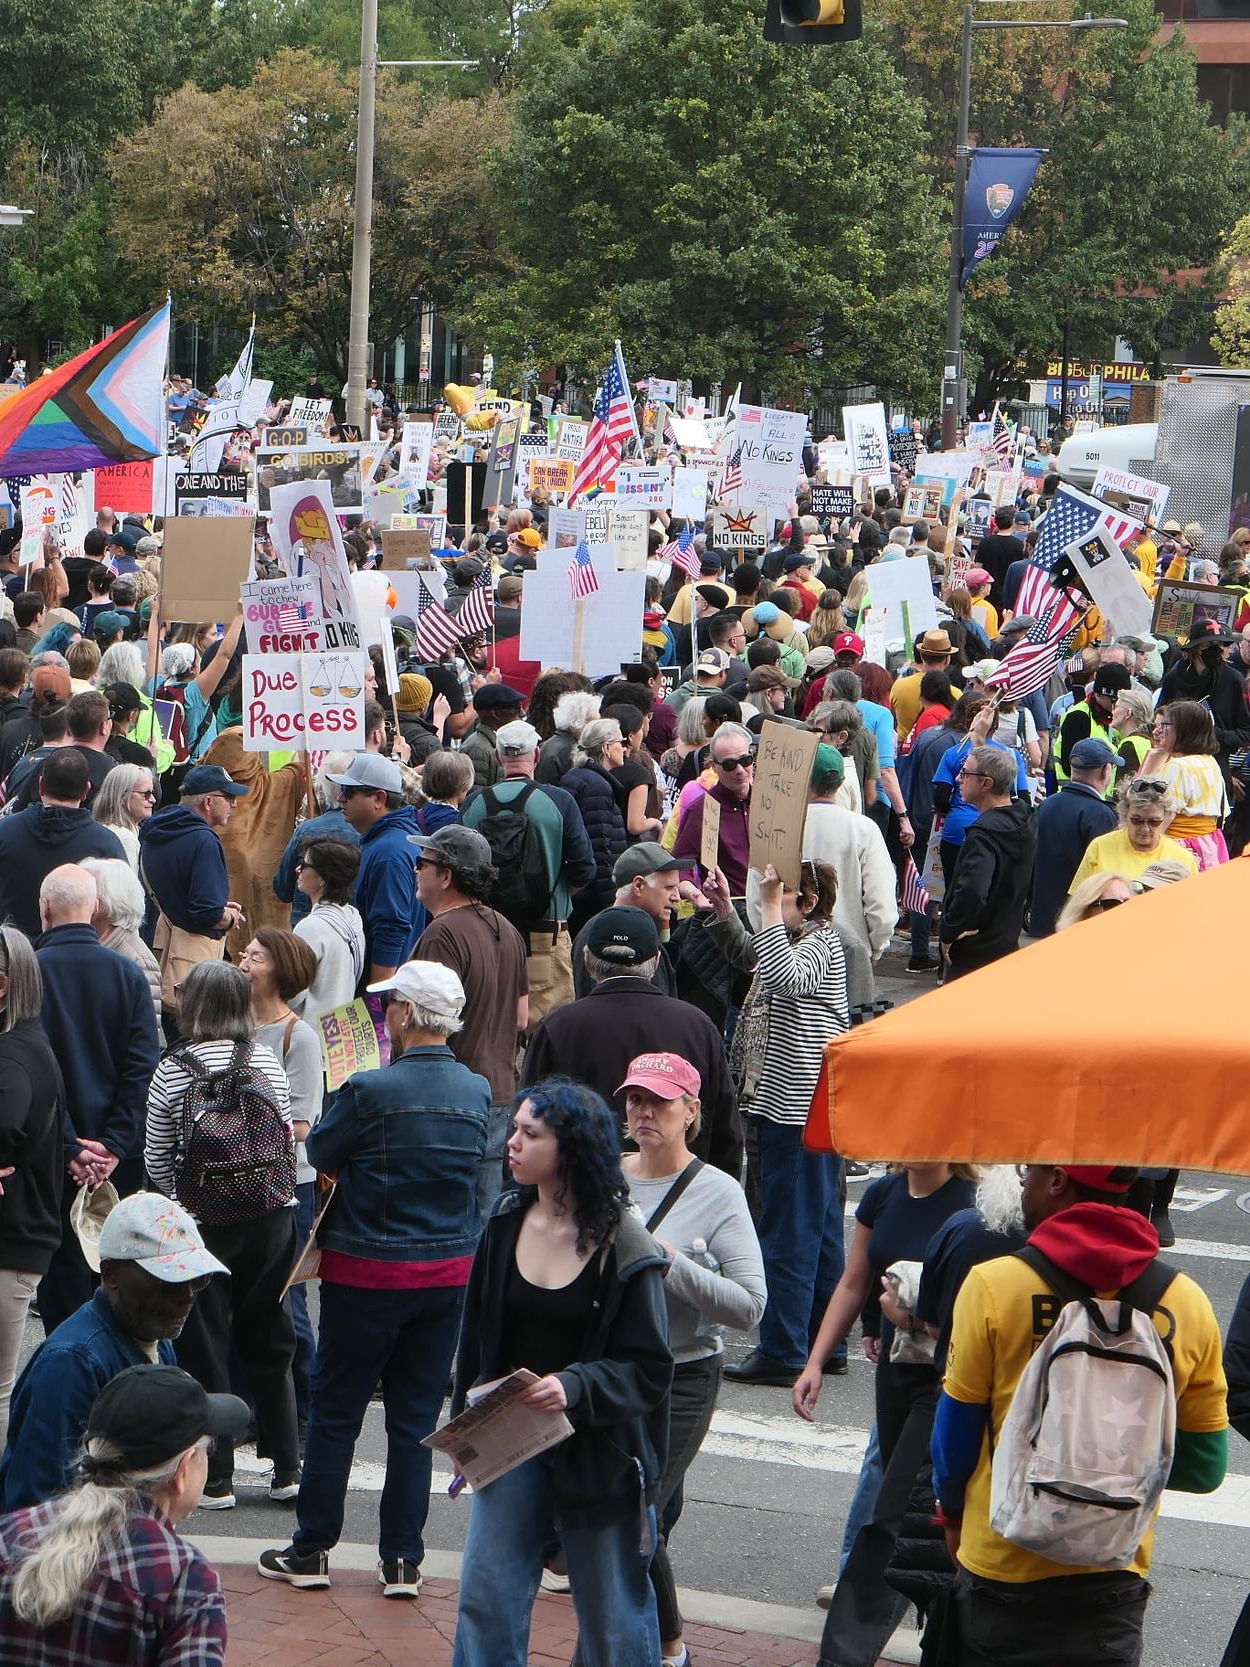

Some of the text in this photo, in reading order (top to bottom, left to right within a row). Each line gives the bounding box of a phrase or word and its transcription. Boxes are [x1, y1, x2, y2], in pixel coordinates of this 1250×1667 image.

[1053, 386, 1077, 402] Hp
[305, 400, 322, 409] LET
[299, 452, 350, 465] BIRDS!
[1086, 452, 1100, 461] 5011
[97, 465, 150, 477] AMERICA
[547, 467, 568, 477] BREAK
[175, 476, 246, 492] ONE AND THE
[1103, 471, 1140, 492] PROTECT
[1143, 486, 1160, 499] OUR
[812, 489, 852, 497] HATE WILL
[812, 497, 852, 506] NOT MAKE
[812, 505, 852, 513] US GREAT
[714, 533, 765, 545] NO KINGS
[952, 560, 969, 570] SAVE
[954, 572, 966, 581] THE
[242, 581, 313, 598] I came here
[260, 593, 299, 605] to chew
[259, 632, 319, 654] FIGHT
[764, 740, 804, 773] BE KIND
[769, 773, 795, 798] TAKE
[760, 793, 772, 811] NO
[613, 934, 629, 942] POLO
